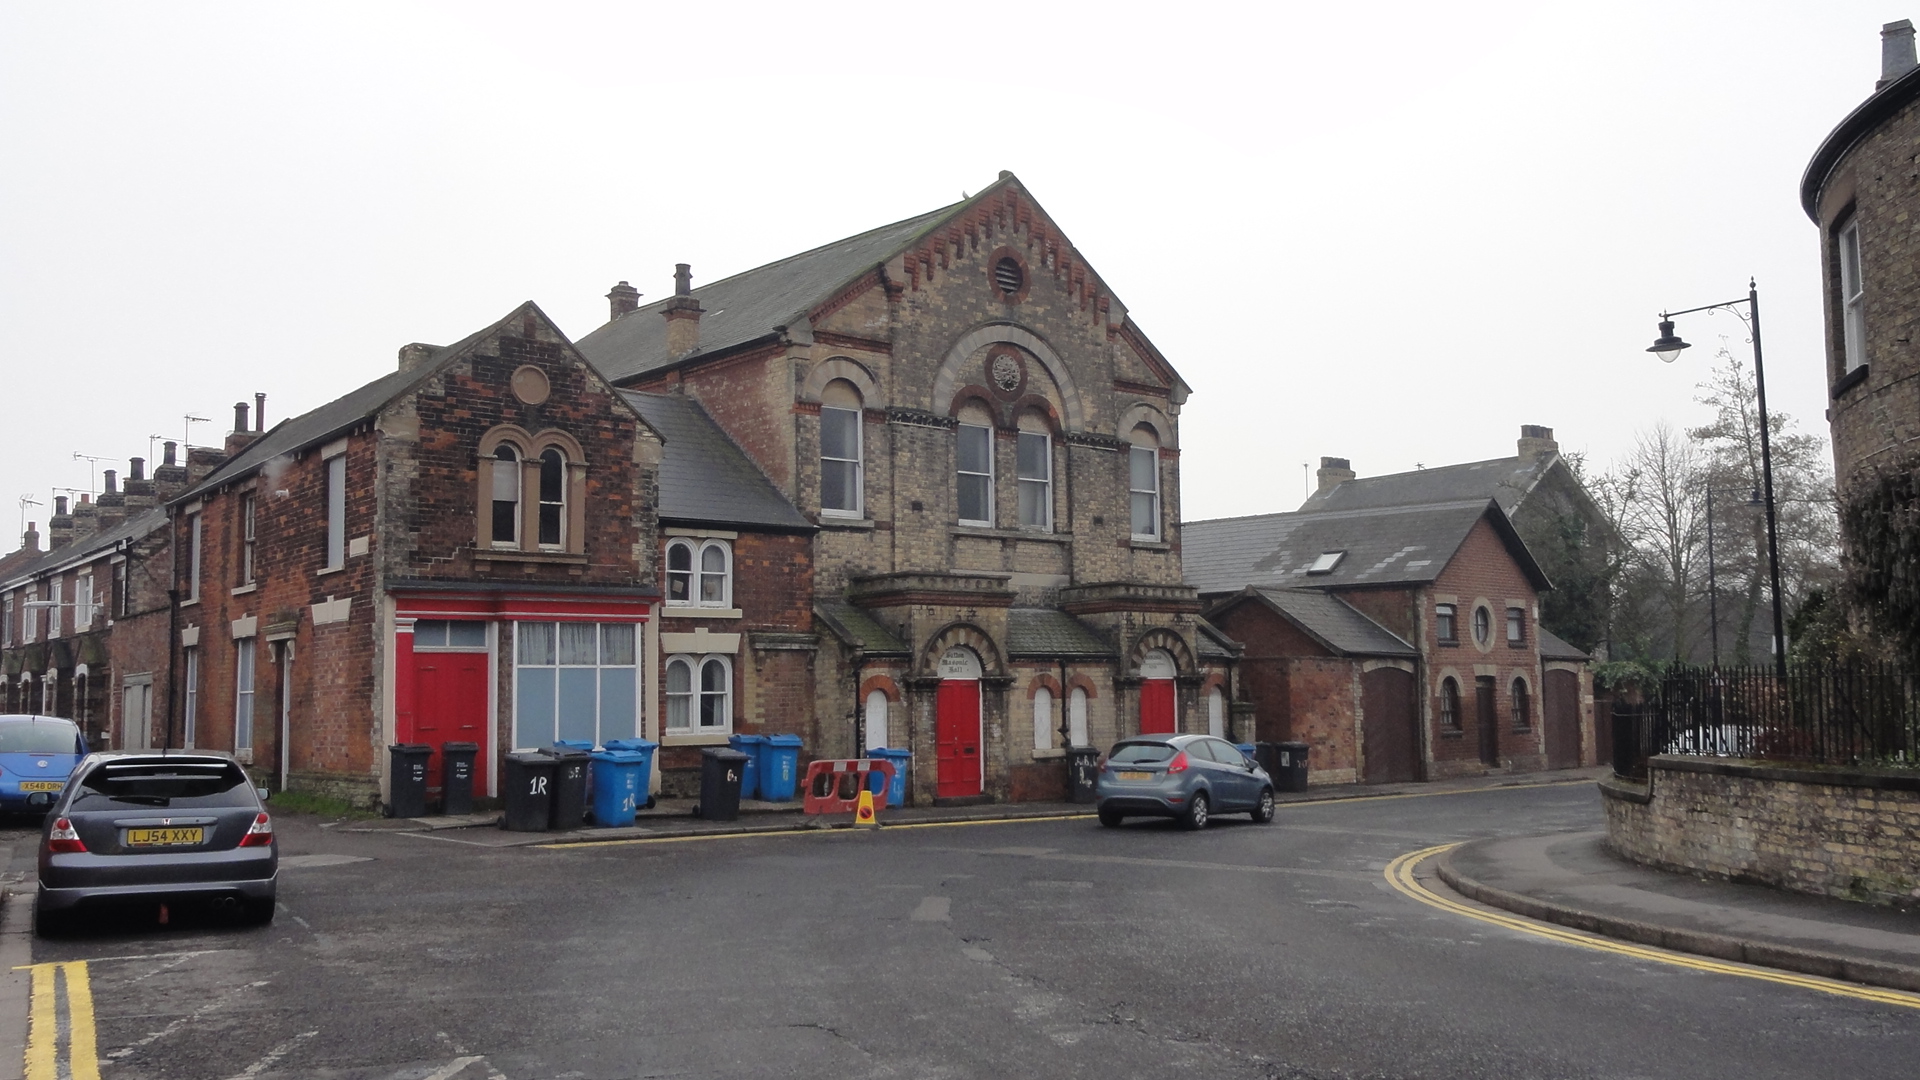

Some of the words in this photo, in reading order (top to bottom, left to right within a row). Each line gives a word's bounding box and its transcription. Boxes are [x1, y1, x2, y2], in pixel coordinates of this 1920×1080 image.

[24, 782, 46, 790] X548
[529, 775, 548, 796] 1R
[133, 830, 168, 843] LJ54
[172, 829, 198, 841] XXY
